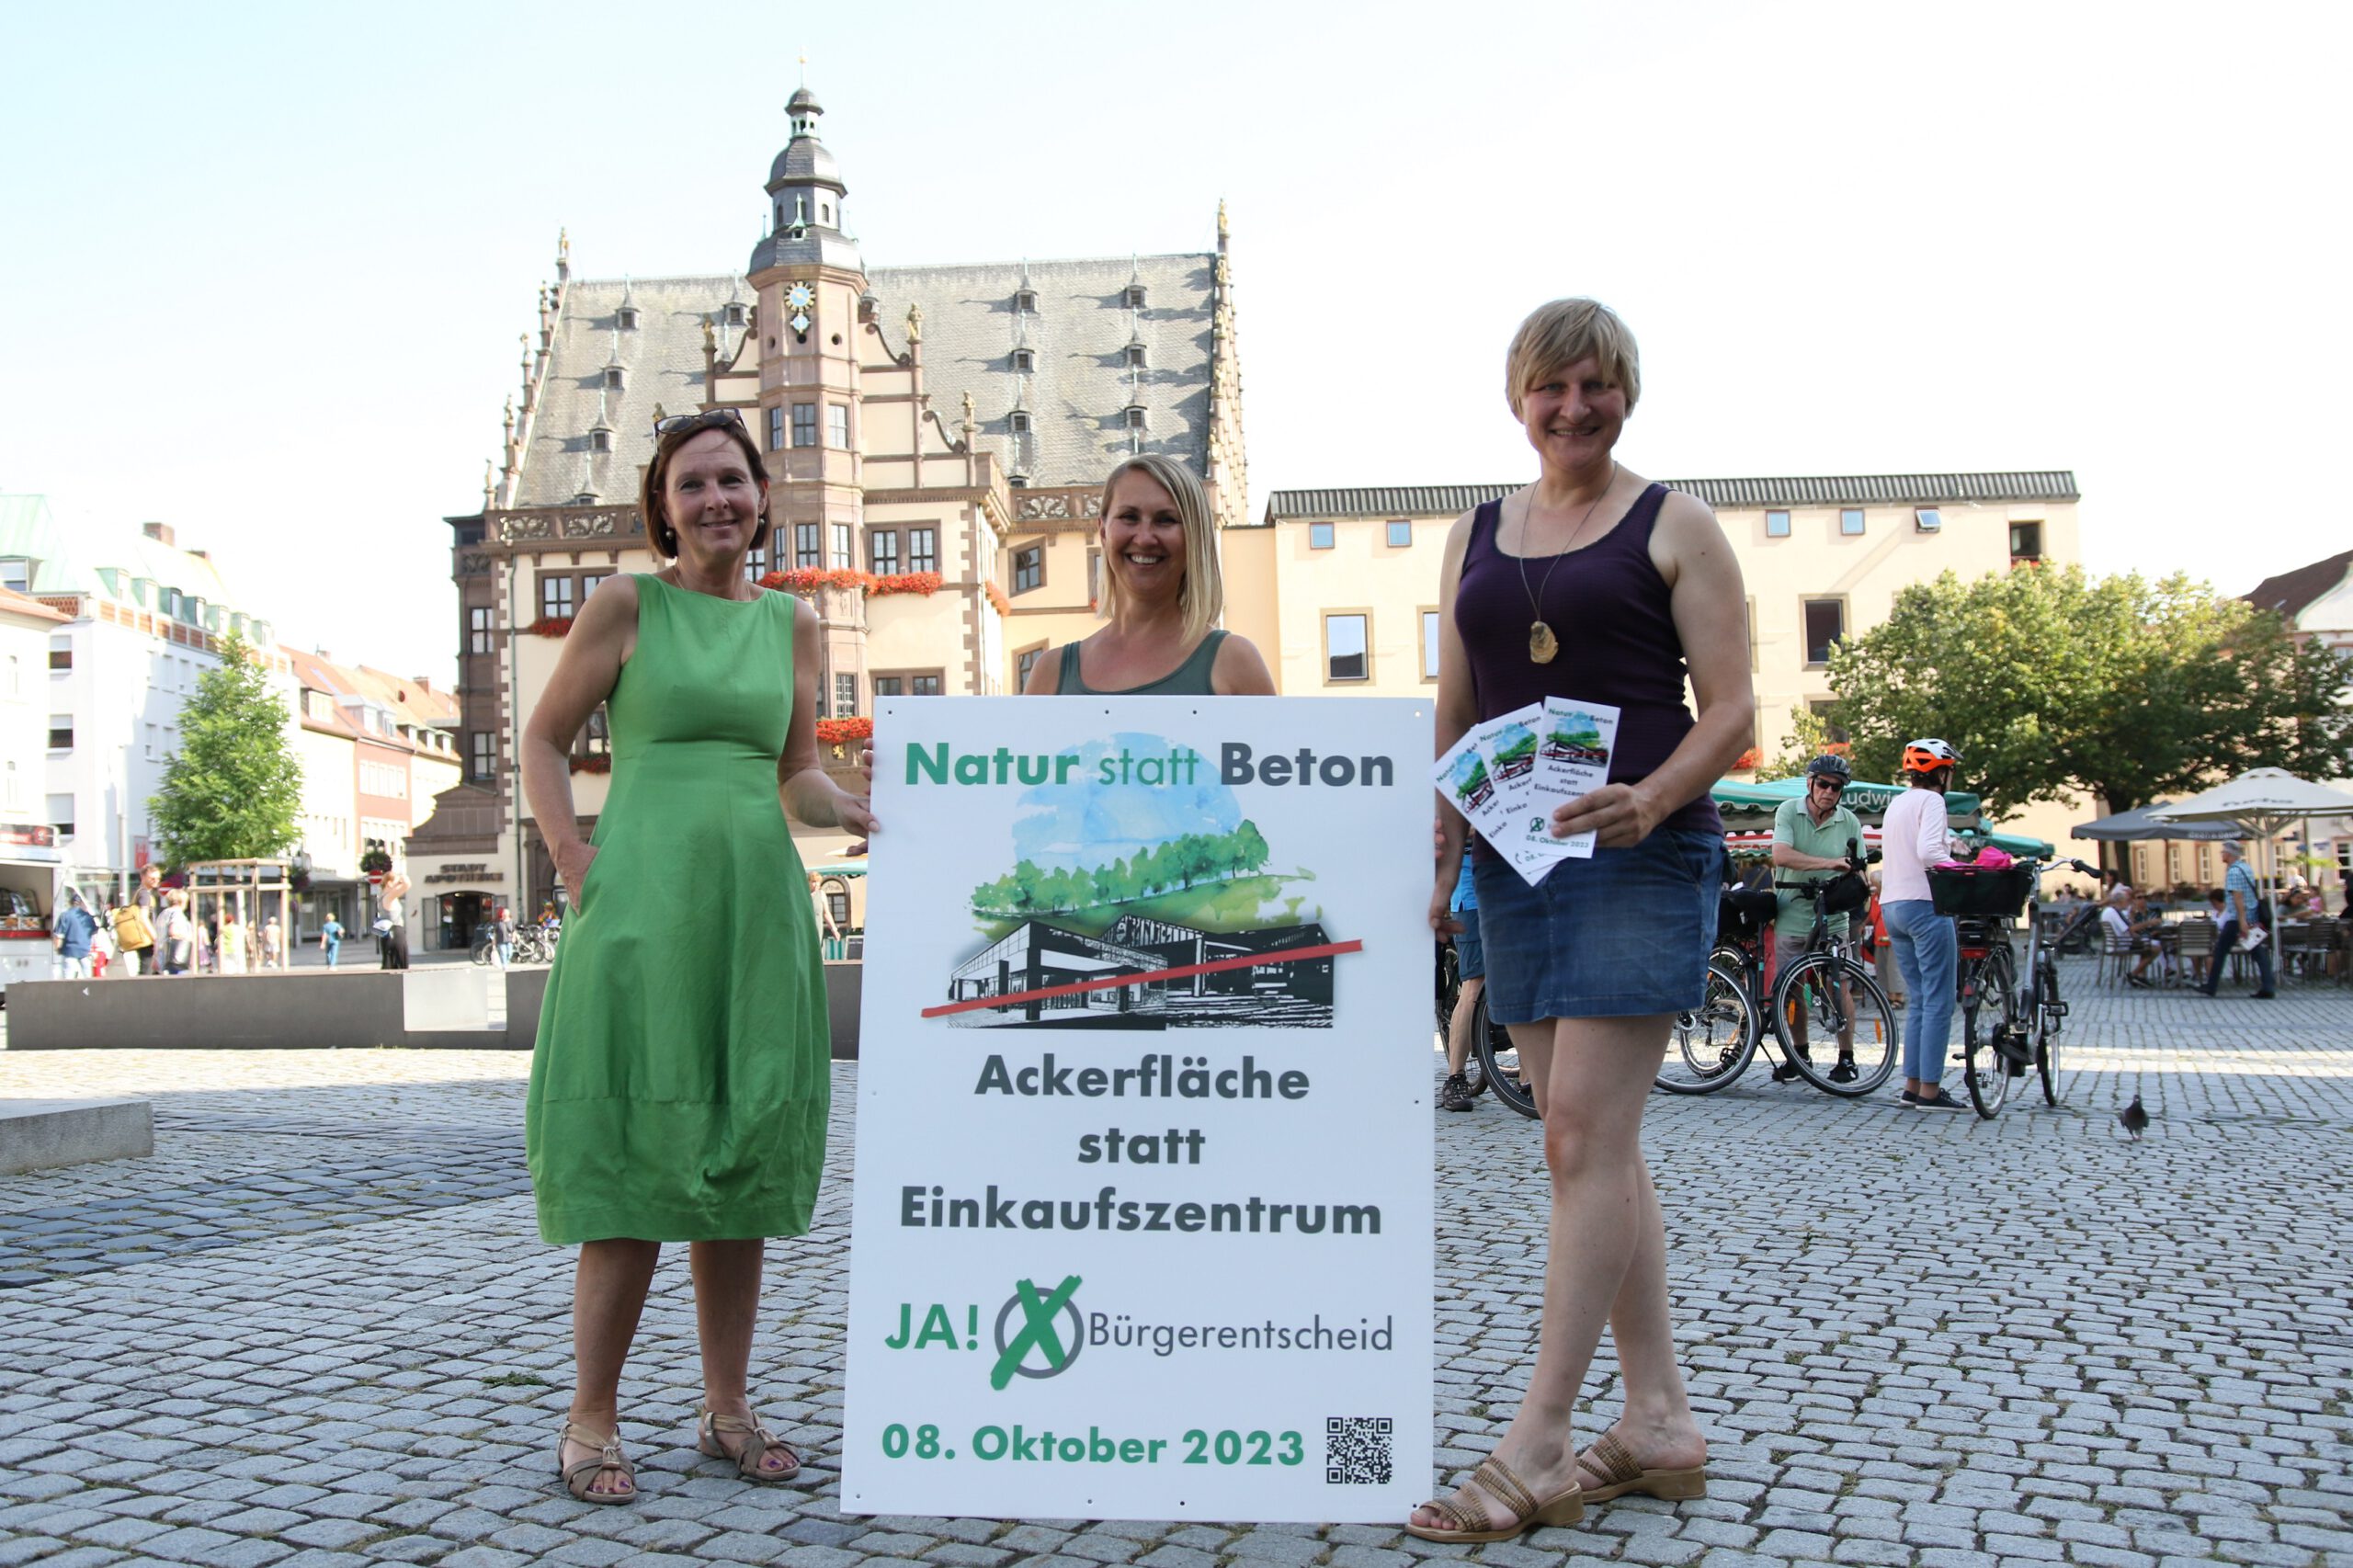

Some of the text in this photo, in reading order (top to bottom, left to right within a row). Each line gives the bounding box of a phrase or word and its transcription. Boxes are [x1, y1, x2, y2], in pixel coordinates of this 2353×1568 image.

[905, 743, 1393, 787] Natur statt Beton
[974, 1053, 1310, 1100] Ackerfläche
[1078, 1128, 1206, 1165] statt
[901, 1186, 1381, 1234] Einkaufszentrum
[885, 1303, 1393, 1357] JA! Bürgerentscheid
[881, 1423, 1305, 1467] 08. Oktober 2023
